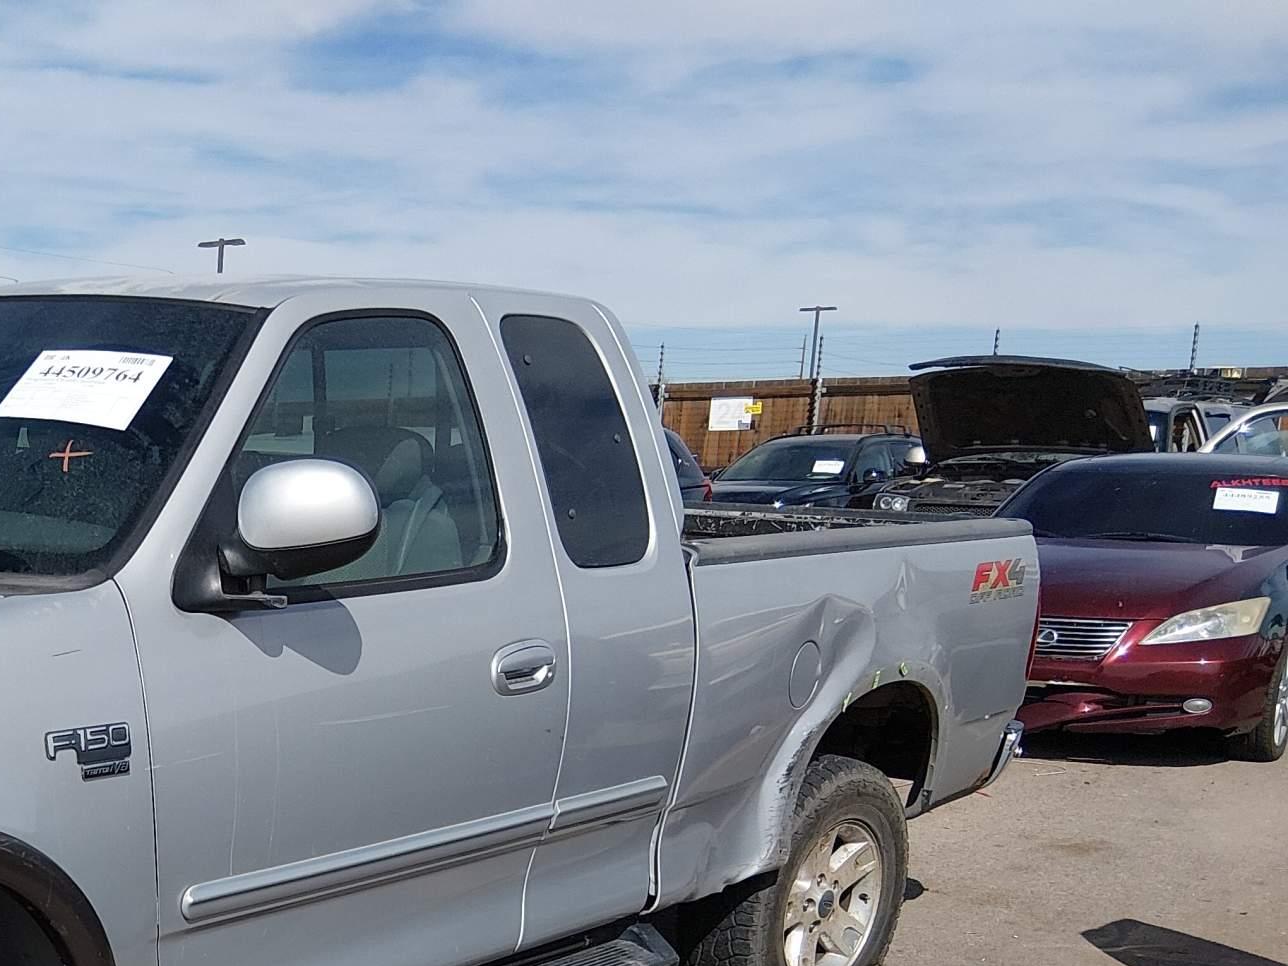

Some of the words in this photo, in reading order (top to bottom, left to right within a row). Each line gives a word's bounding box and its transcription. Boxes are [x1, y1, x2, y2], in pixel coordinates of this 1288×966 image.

[38, 364, 145, 384] 44509764
[971, 557, 1026, 593] FX4
[46, 722, 130, 758] F-150
